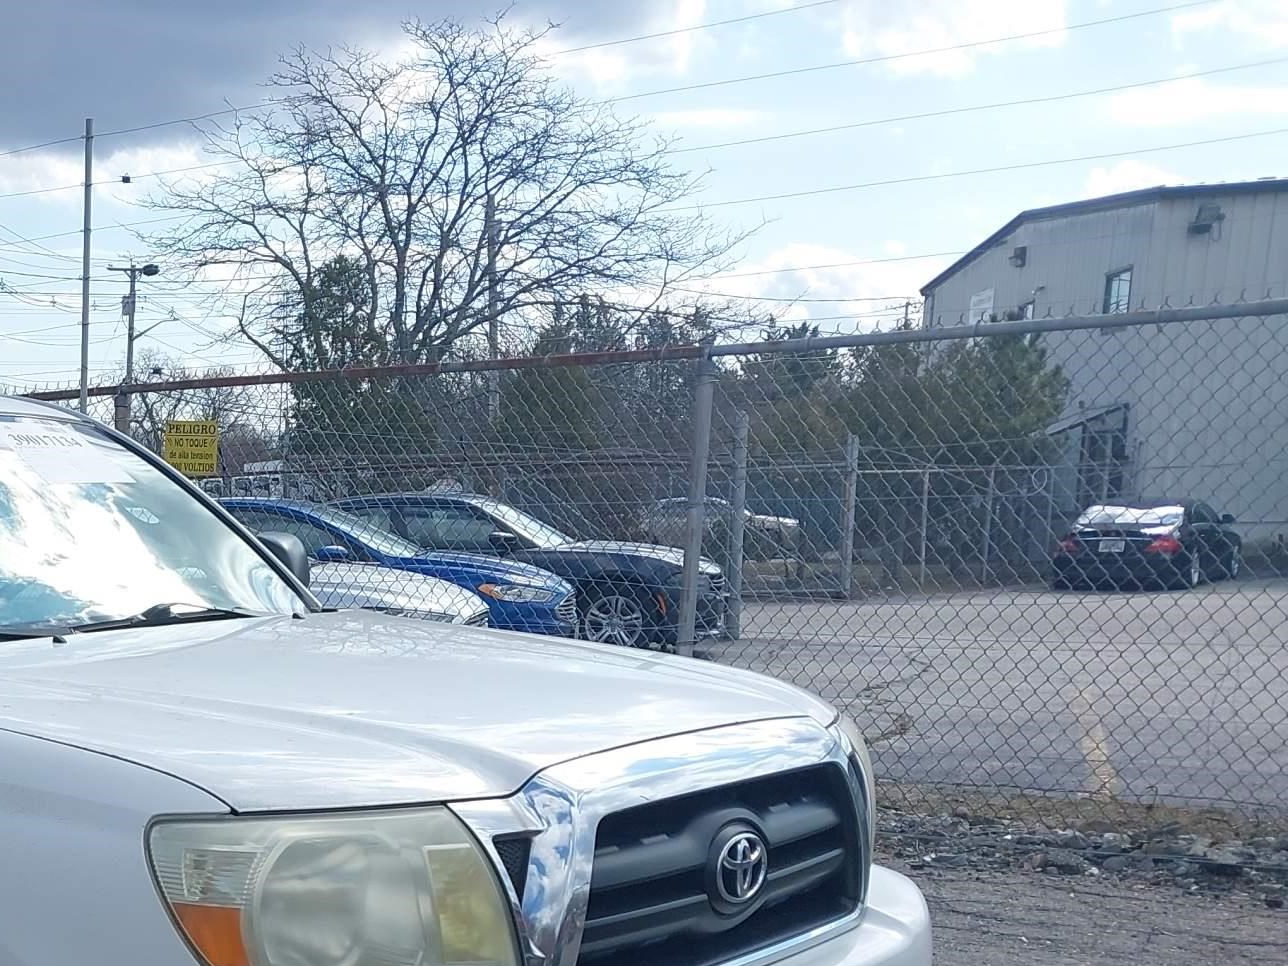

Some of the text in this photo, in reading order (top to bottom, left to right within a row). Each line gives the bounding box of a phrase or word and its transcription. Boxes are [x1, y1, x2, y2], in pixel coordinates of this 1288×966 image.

[168, 424, 216, 434] PELIGRO
[7, 432, 83, 448] 39017134
[175, 438, 208, 447] NO TOQUE
[183, 462, 215, 472] VOLTIOS
